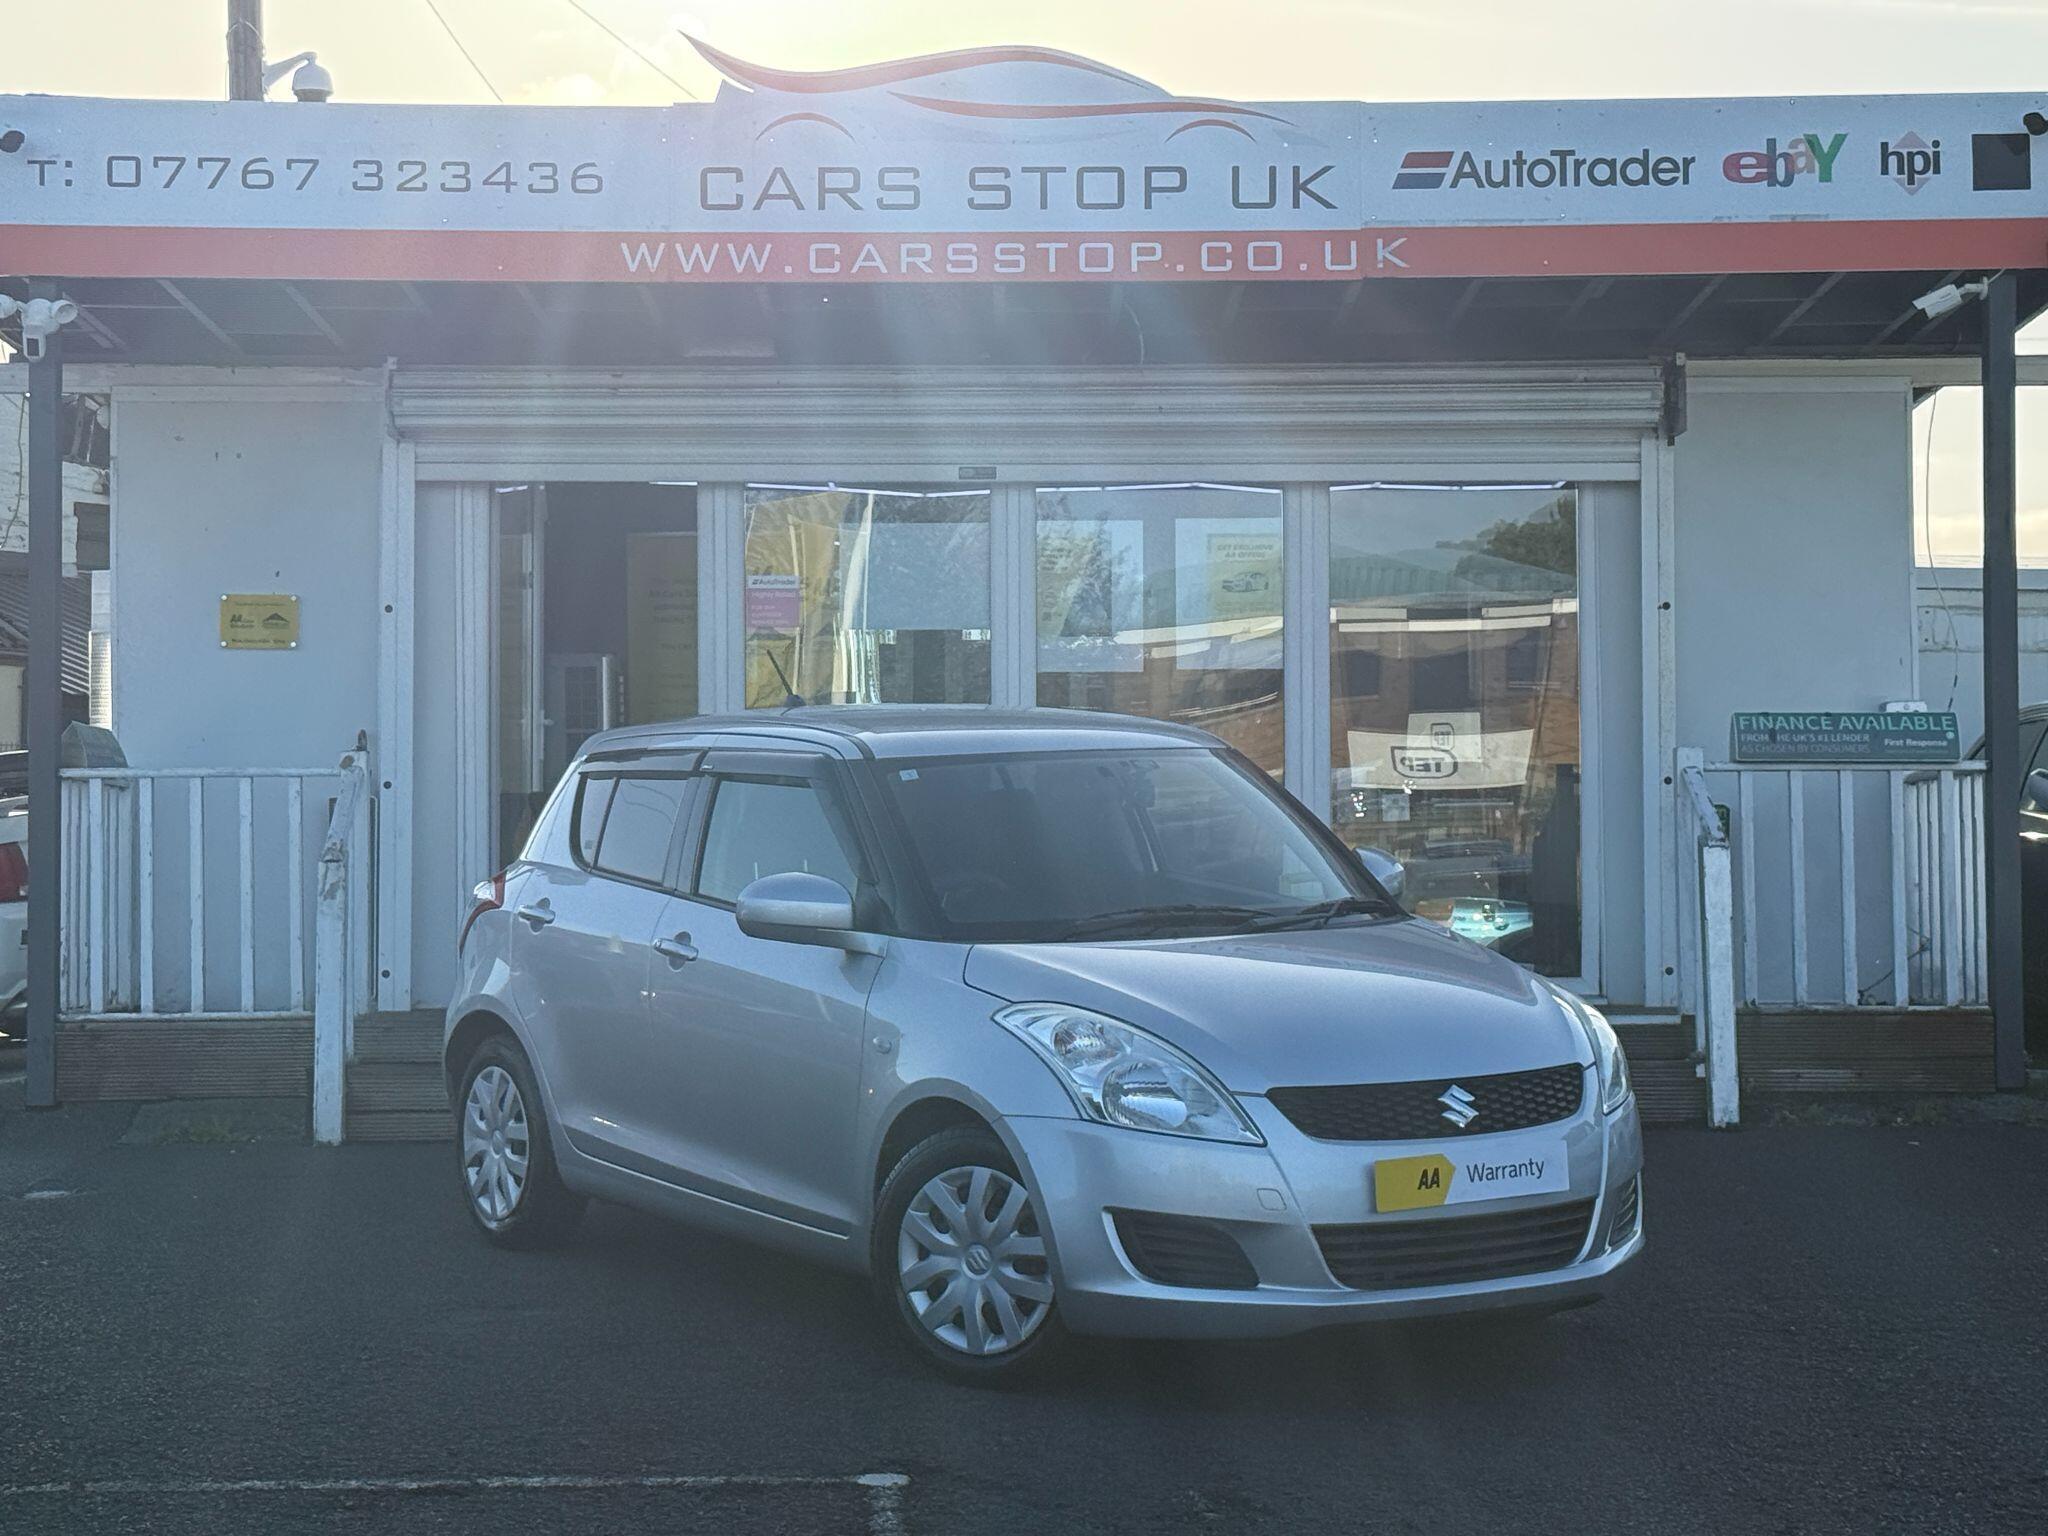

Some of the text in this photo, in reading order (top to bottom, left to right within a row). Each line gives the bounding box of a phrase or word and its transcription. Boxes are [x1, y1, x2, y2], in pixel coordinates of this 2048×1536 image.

[27, 154, 605, 195] T: 07767 323436
[1450, 148, 1696, 189] AutoTrader
[1881, 140, 1941, 190] hpi
[700, 165, 1339, 212] CARS STOP UK
[620, 236, 1411, 275] WWW.CARSSTOP.CO.UK
[1739, 715, 1955, 731] FINANCE AVAILABLE
[1741, 733, 1770, 743] FROM
[1831, 733, 1870, 743] LENDER
[1884, 738, 1948, 748] First Response
[1417, 1157, 1545, 1190] AA Warranty
